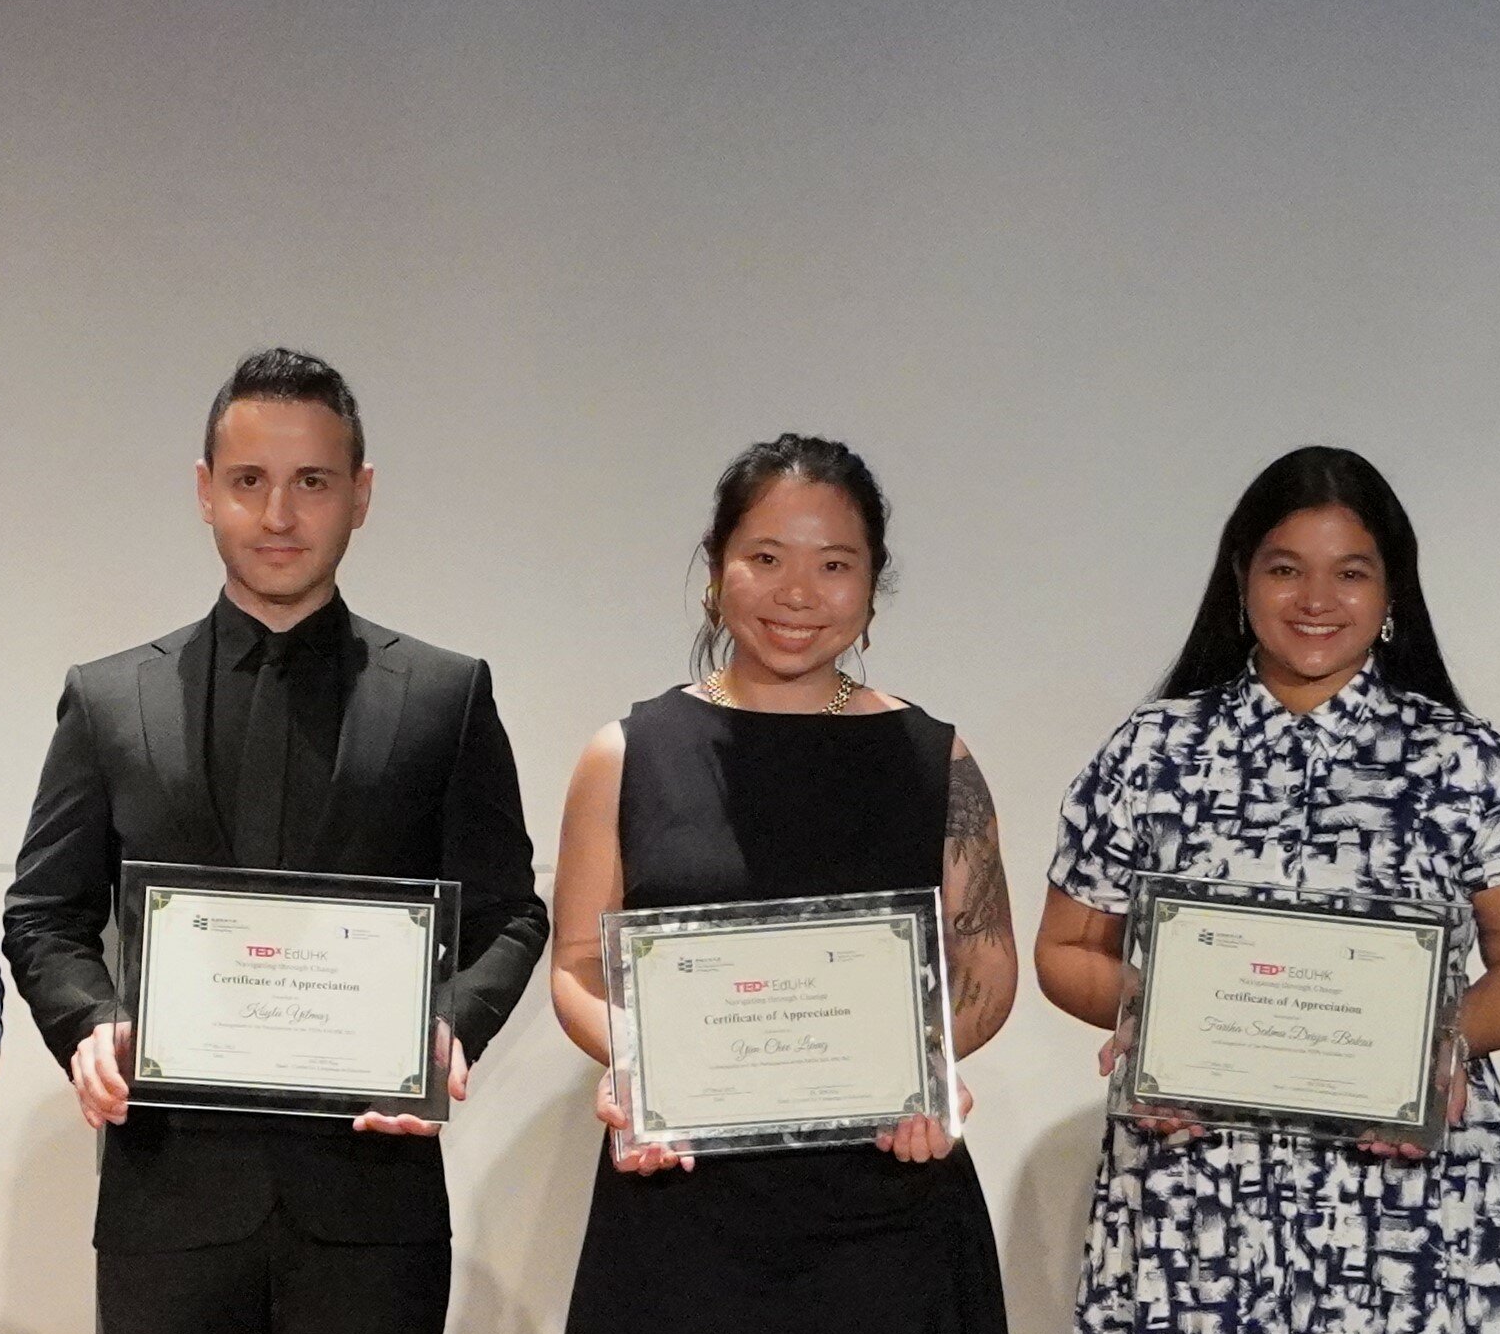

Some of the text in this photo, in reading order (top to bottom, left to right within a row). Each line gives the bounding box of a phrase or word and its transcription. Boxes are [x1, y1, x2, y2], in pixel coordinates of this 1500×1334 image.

[247, 946, 328, 961] TEDx EdUHK
[1250, 963, 1333, 981] TEDx EdUHK
[213, 973, 360, 991] Certificate of Appreciation
[734, 978, 816, 993] TEDx EdUHK
[1215, 989, 1362, 1014] Certificate of Appreciation
[704, 1006, 850, 1025] Certificate of Appreciation
